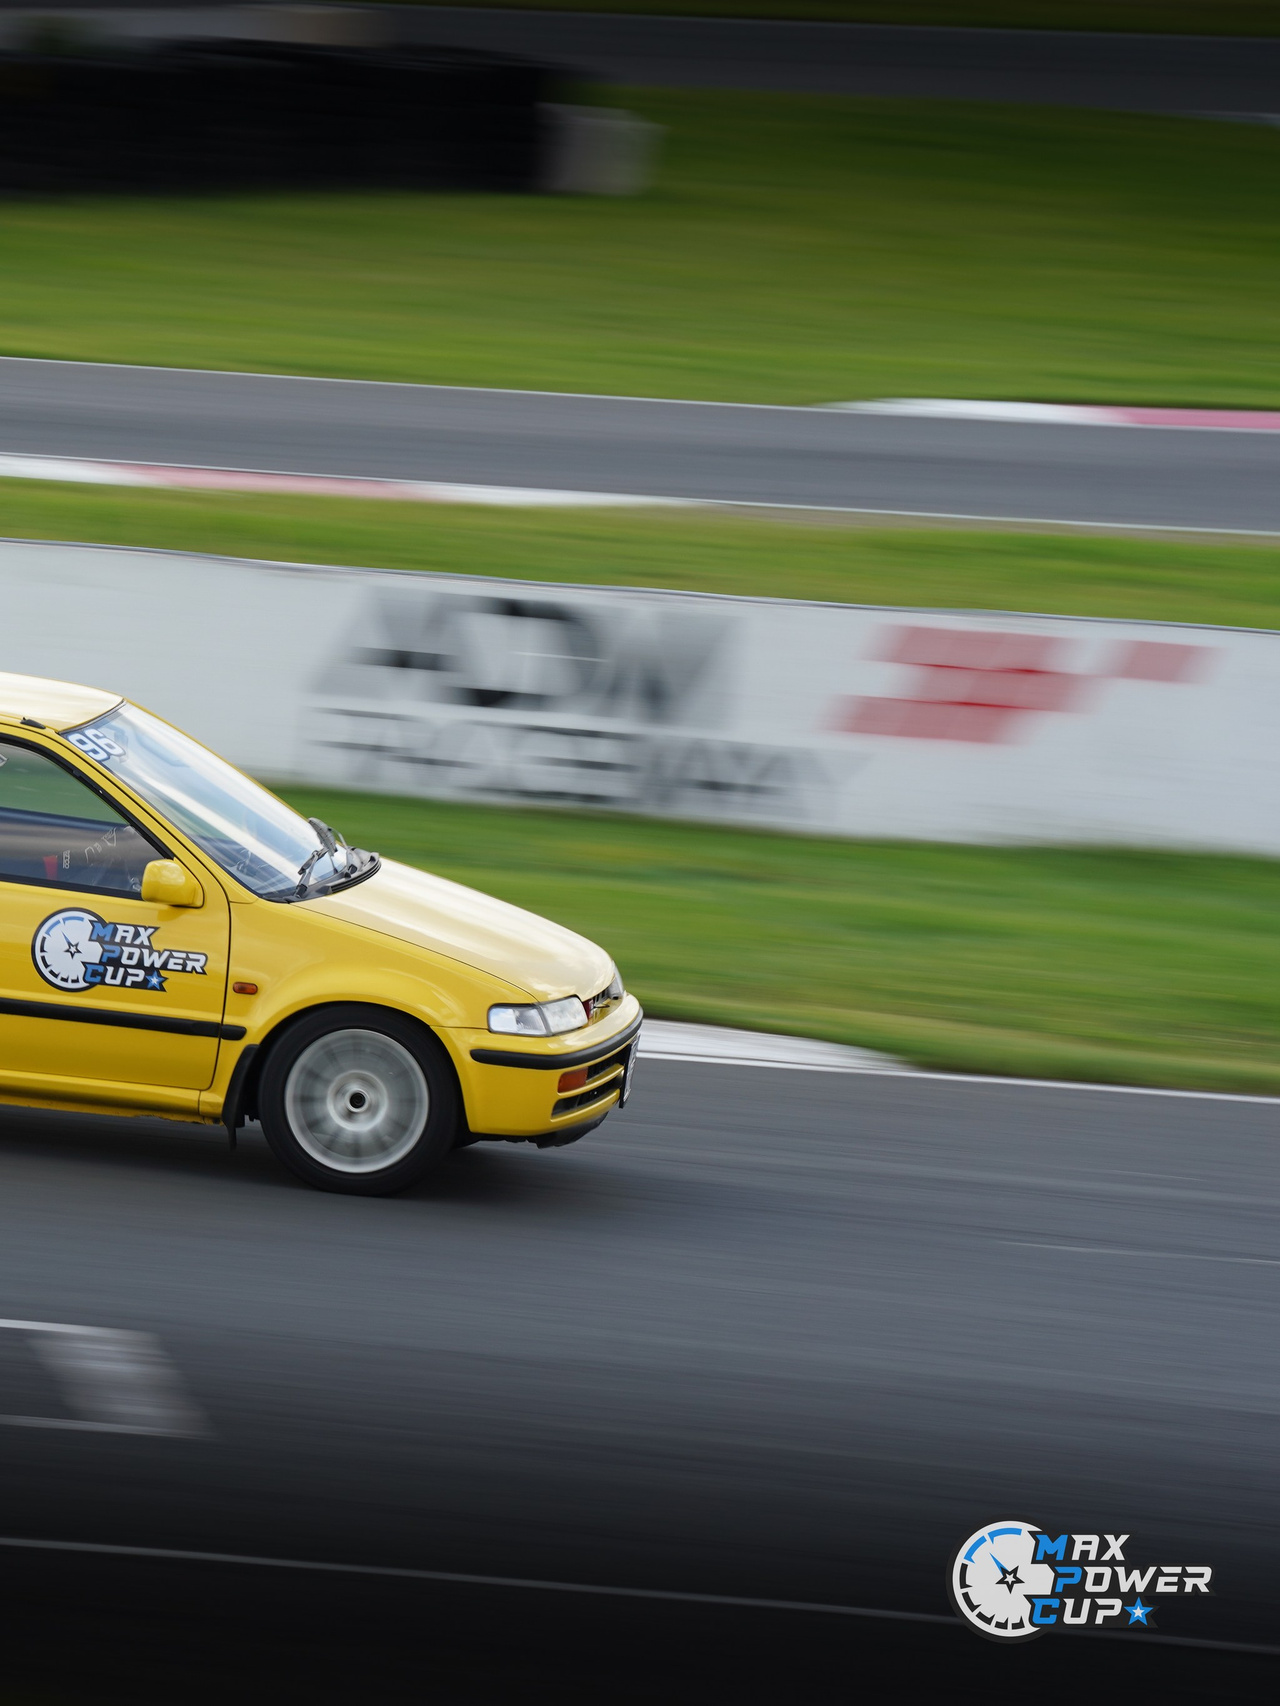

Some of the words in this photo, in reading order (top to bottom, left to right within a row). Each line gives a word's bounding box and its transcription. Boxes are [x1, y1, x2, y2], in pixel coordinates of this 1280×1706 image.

[67, 728, 126, 761] 96
[91, 922, 157, 946] MAX
[102, 945, 206, 973] POWER
[85, 962, 145, 987] CUP
